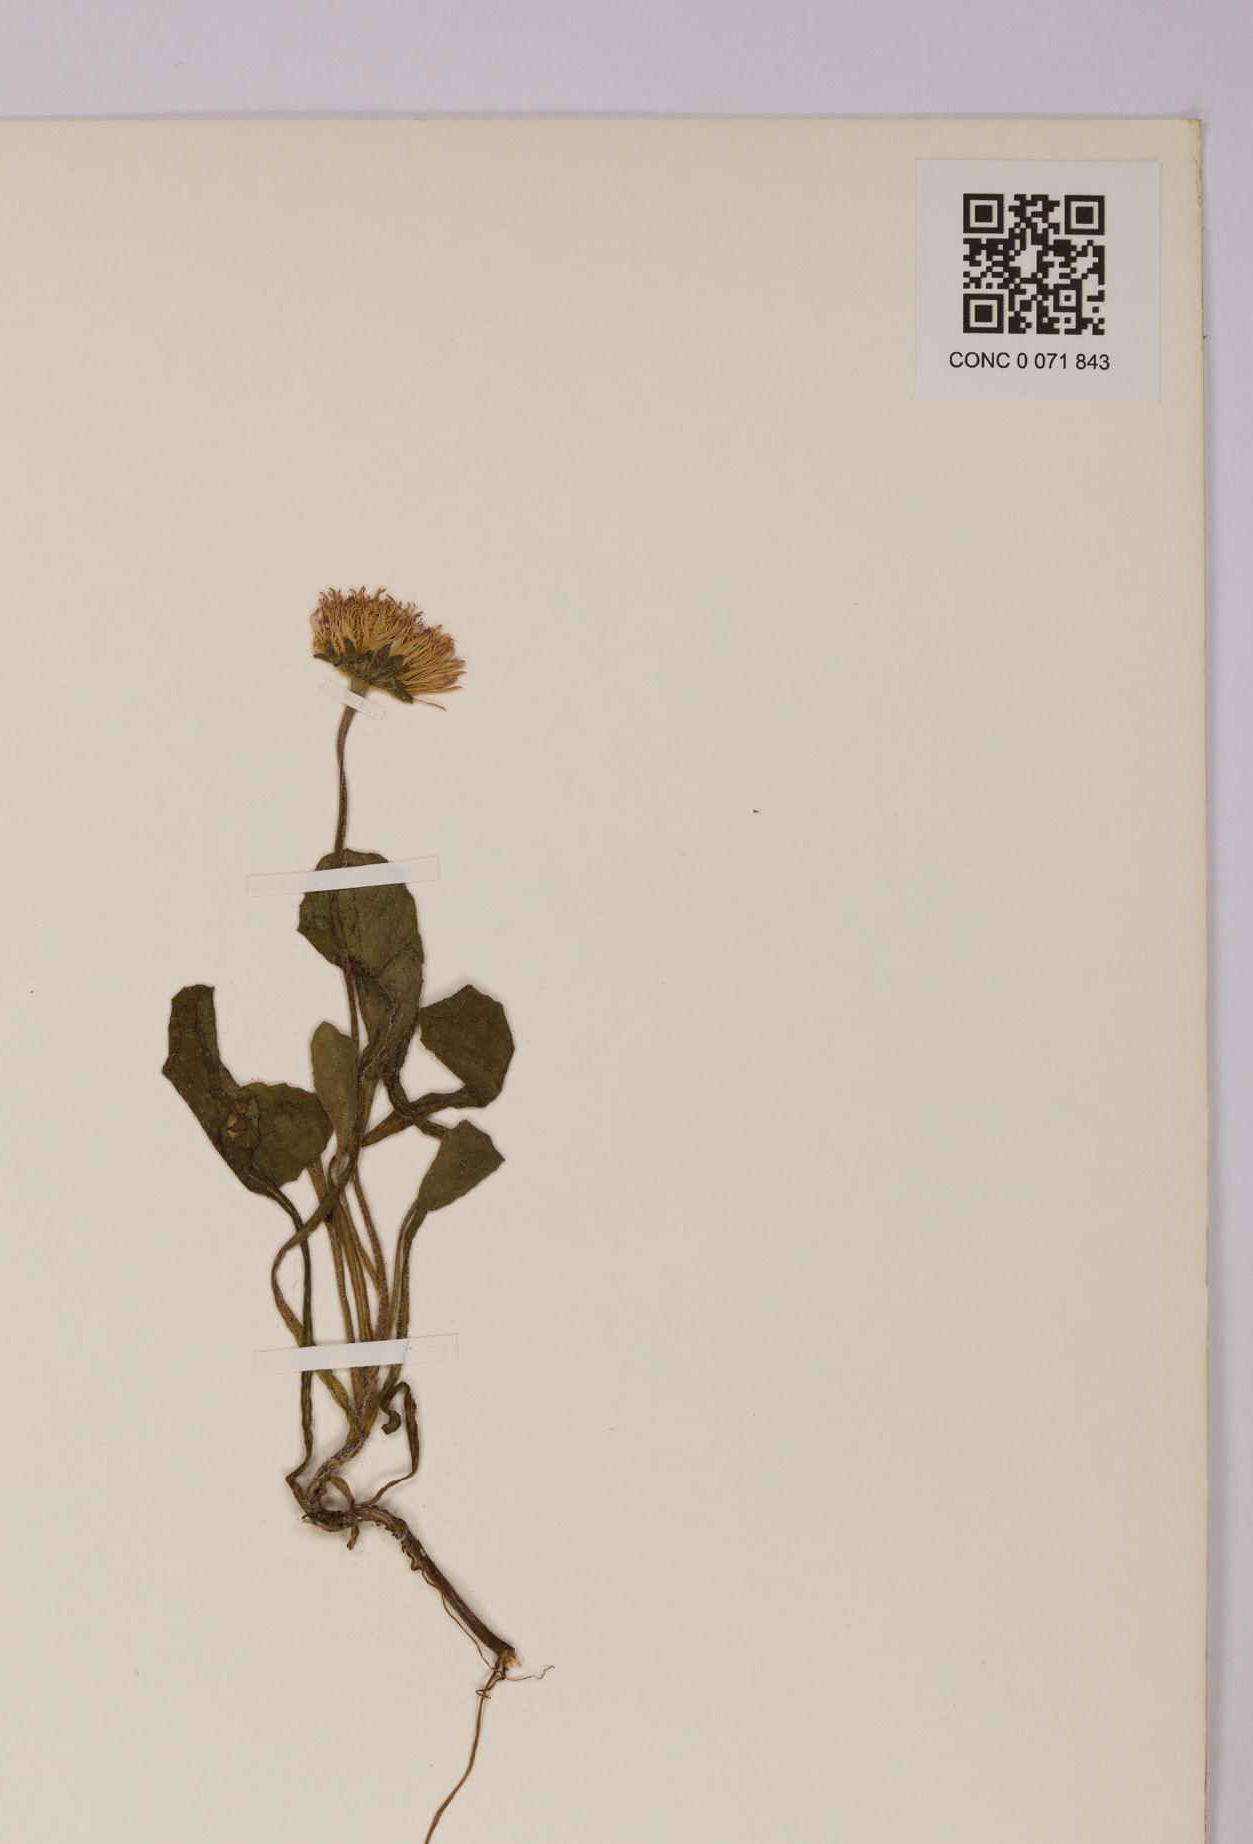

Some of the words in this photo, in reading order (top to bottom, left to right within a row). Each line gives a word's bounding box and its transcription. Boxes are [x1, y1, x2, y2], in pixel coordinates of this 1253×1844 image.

[949, 351, 1011, 369] CONC
[1016, 352, 1028, 369] 0
[1034, 352, 1067, 370] 071
[1075, 353, 1110, 371] 843
